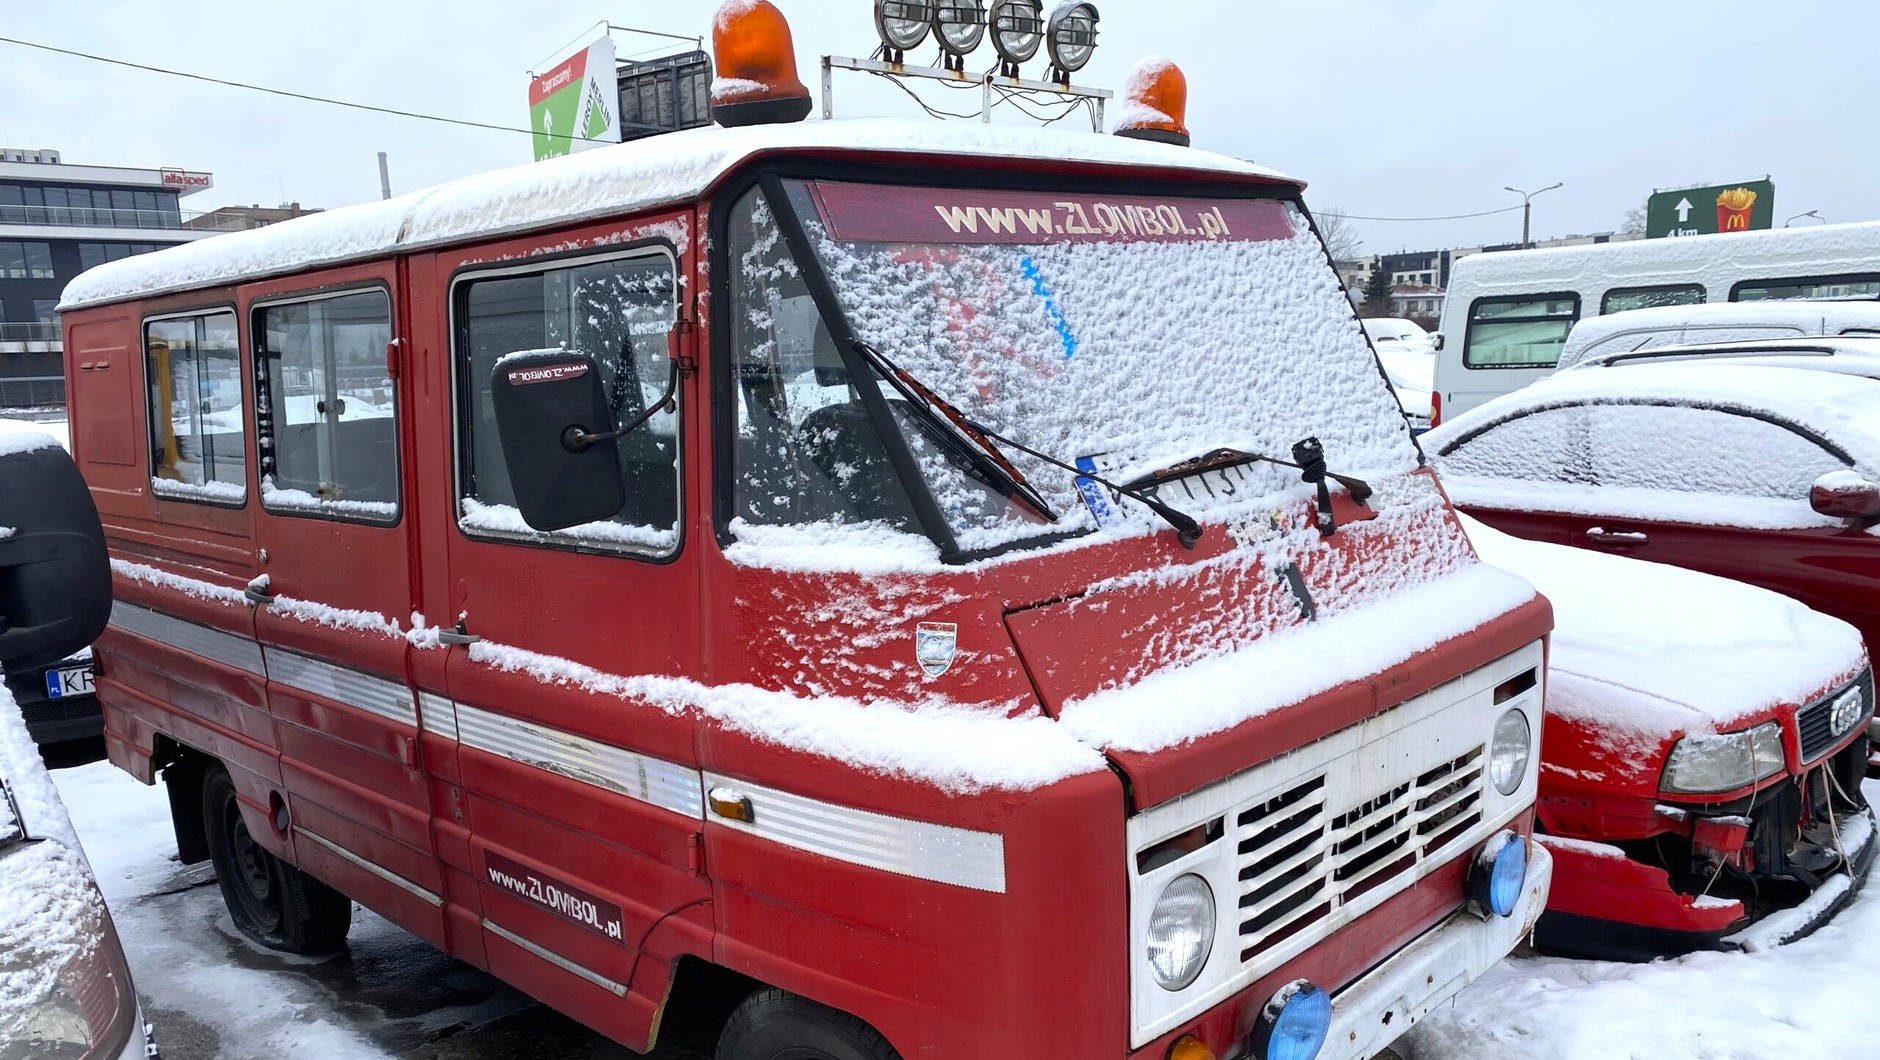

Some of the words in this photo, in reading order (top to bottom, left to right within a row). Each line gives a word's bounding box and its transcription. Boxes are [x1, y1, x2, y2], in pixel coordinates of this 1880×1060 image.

[580, 91, 594, 139] LEROY
[590, 75, 612, 128] MERLIN
[934, 202, 1231, 238] www.ZLOMBOL.pl
[488, 867, 622, 940] www.ZLOMBOL.pl
